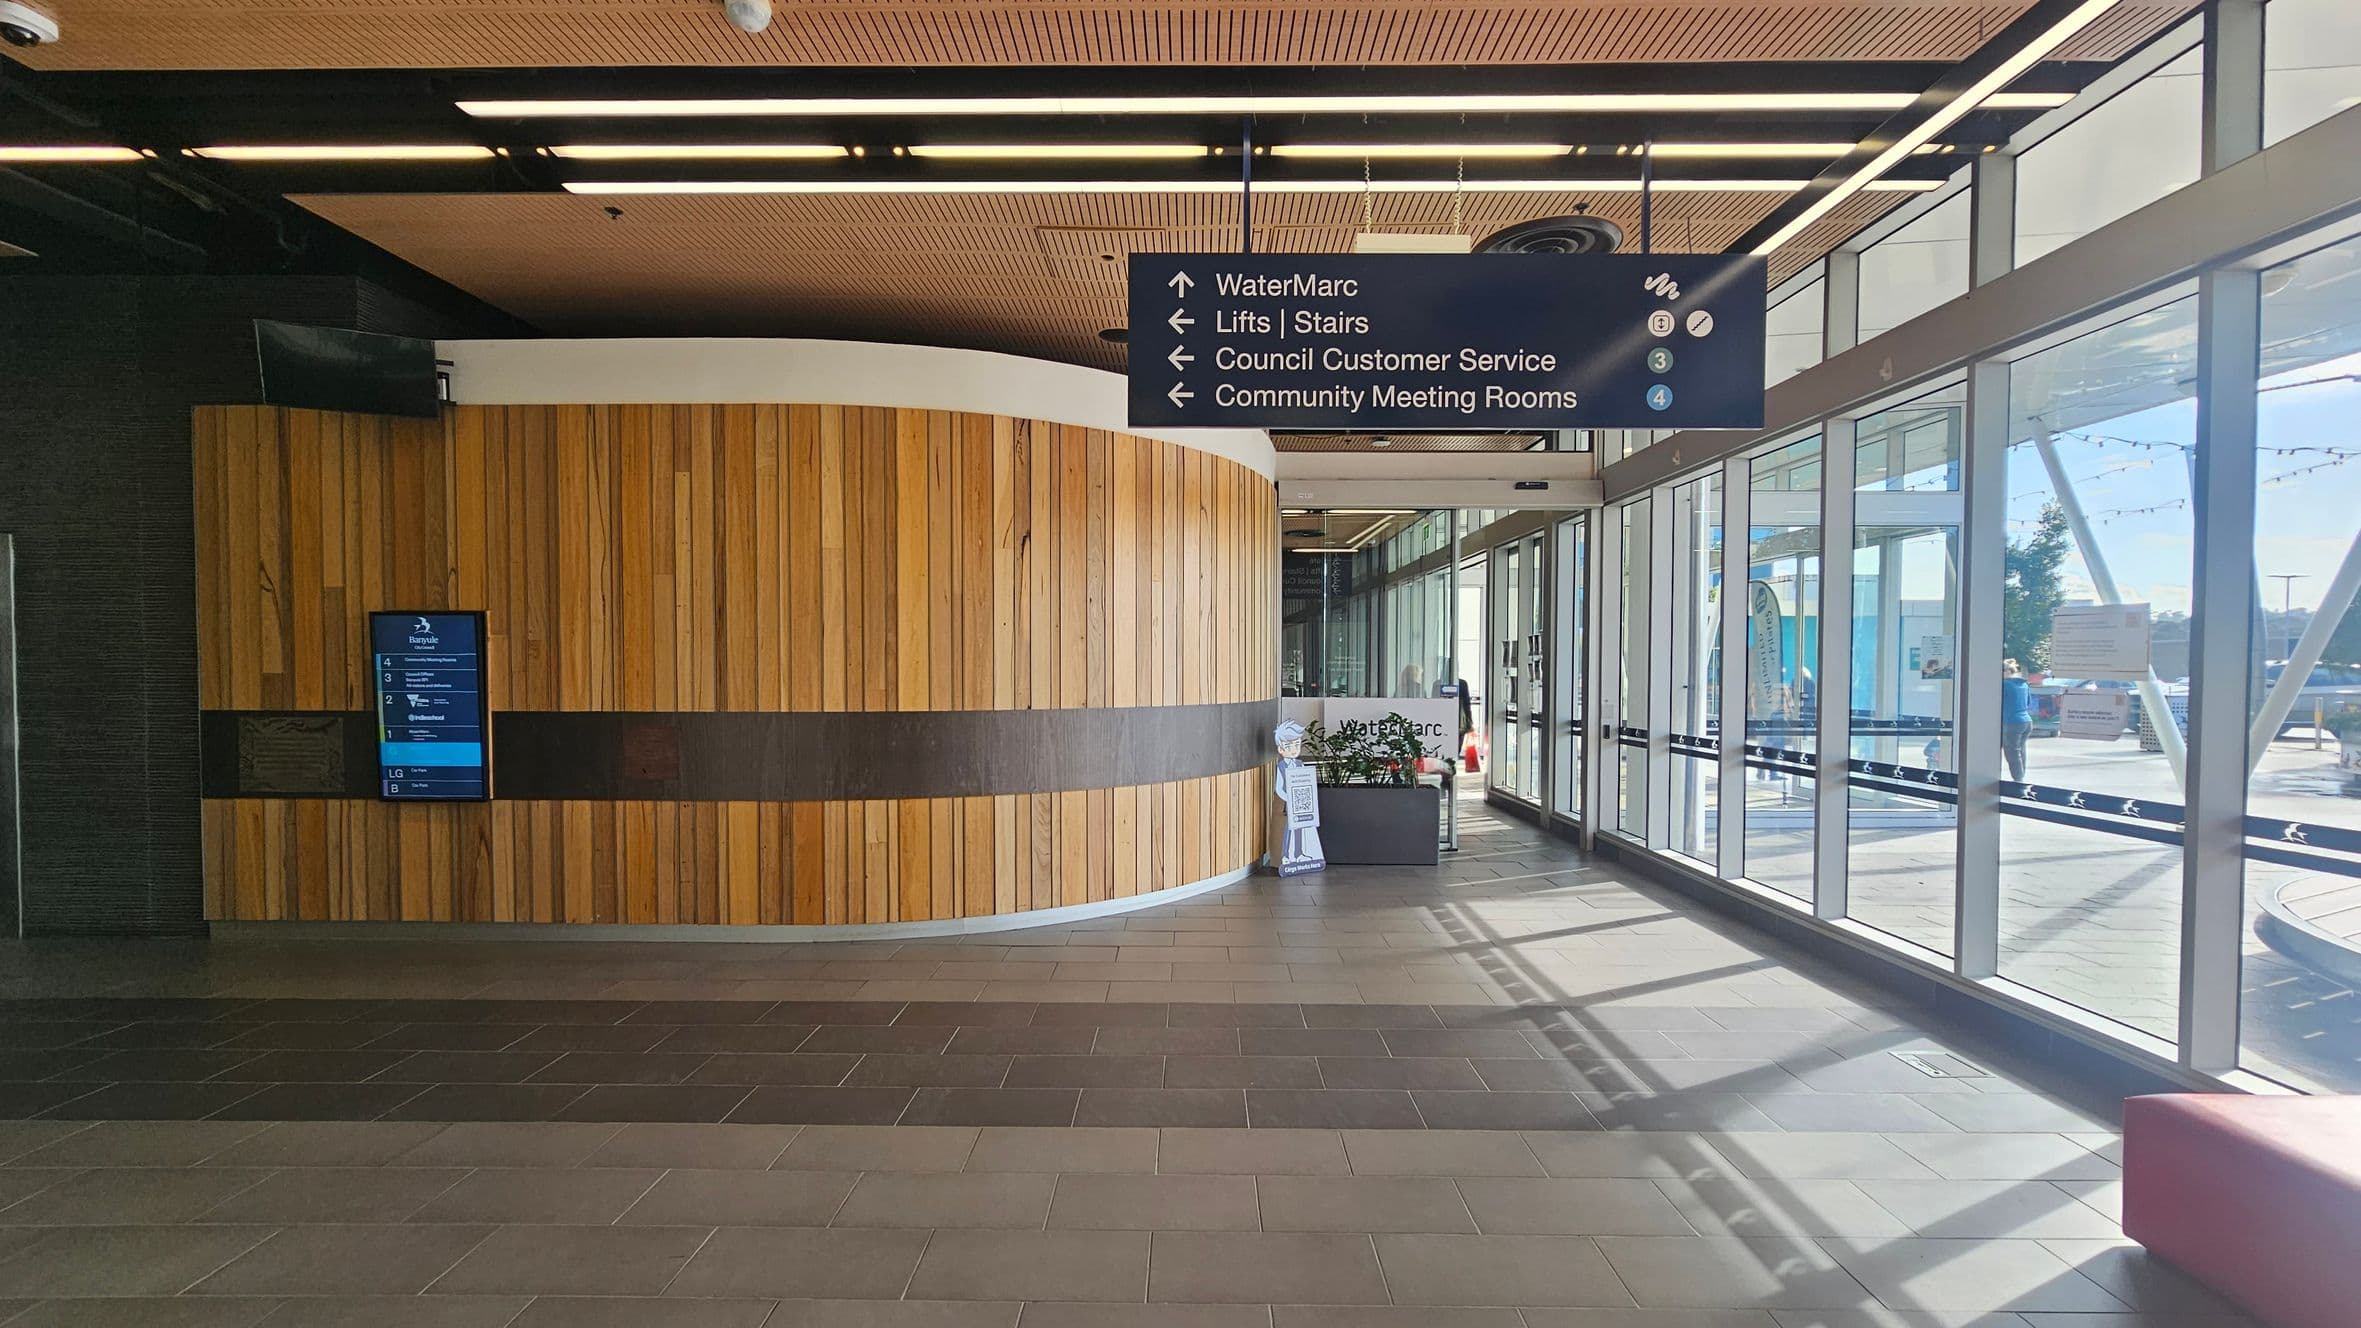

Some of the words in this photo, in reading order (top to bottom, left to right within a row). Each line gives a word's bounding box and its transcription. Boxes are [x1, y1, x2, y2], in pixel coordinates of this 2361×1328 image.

[1215, 273, 1358, 297] WaterMarc
[1216, 310, 1270, 334] Lifts
[1294, 310, 1369, 334] Stairs
[1215, 347, 1313, 371] Council
[1322, 348, 1452, 371] Customer
[1459, 348, 1556, 372] Service
[1653, 352, 1667, 370] 3
[1215, 384, 1365, 414] Community
[1372, 385, 1476, 414] Meeting
[1485, 385, 1578, 409] Rooms
[1652, 389, 1667, 407] 4
[408, 635, 439, 645] Banyule
[383, 657, 392, 667] 4
[384, 673, 392, 682] 3
[385, 695, 393, 704] 2
[387, 729, 392, 739] 1
[1340, 719, 1442, 737] Watearc
[388, 768, 404, 778] LG
[390, 783, 399, 793] B
